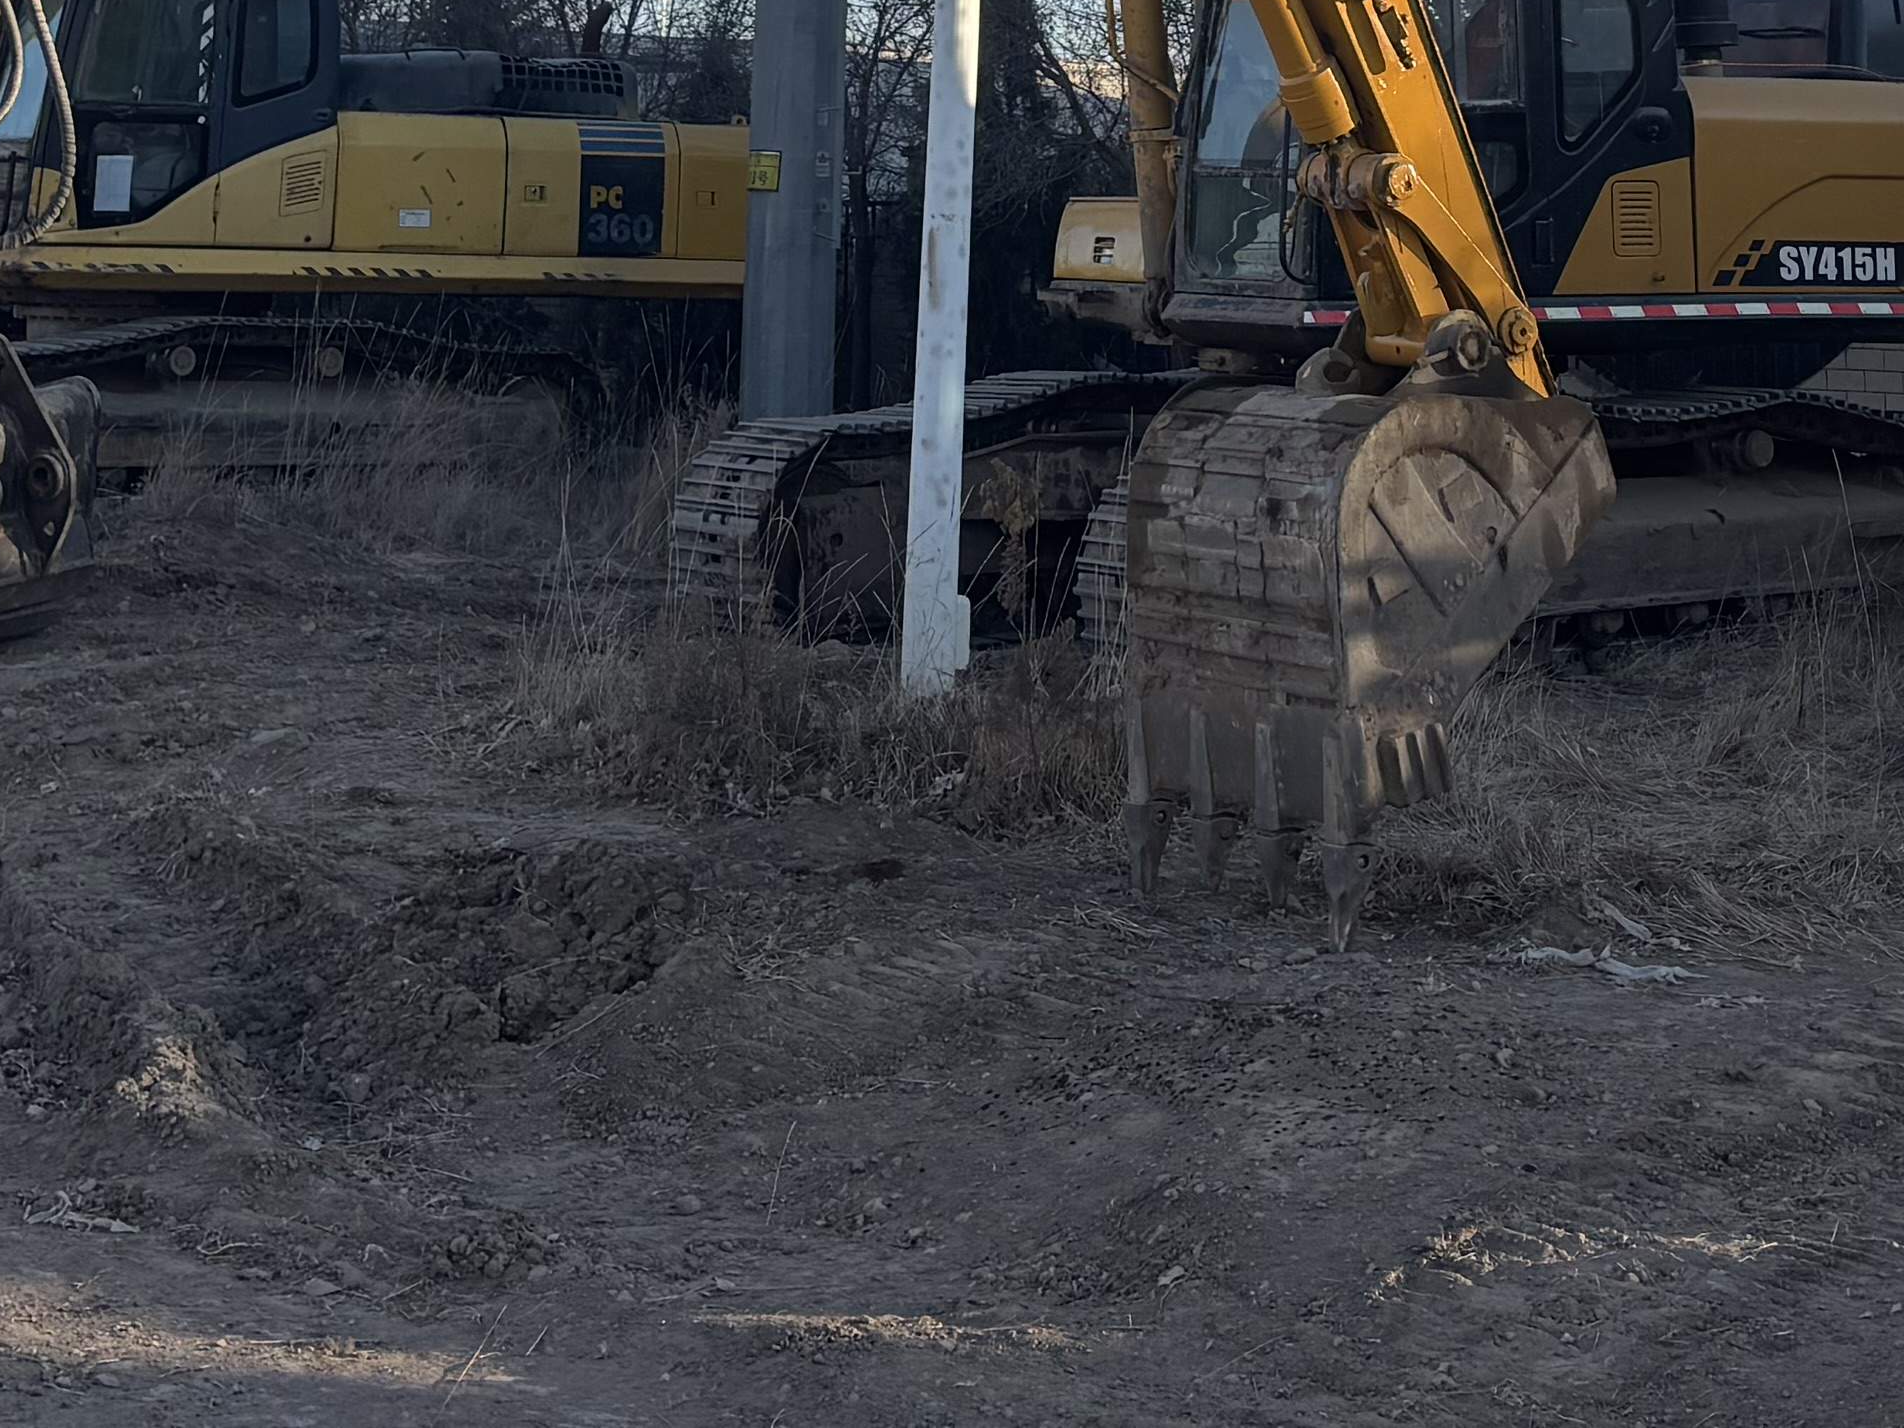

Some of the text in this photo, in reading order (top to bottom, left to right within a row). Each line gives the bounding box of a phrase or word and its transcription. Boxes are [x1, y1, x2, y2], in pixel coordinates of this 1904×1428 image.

[590, 185, 623, 209] PC
[587, 213, 654, 245] 360
[1779, 246, 1896, 281] SY415H
